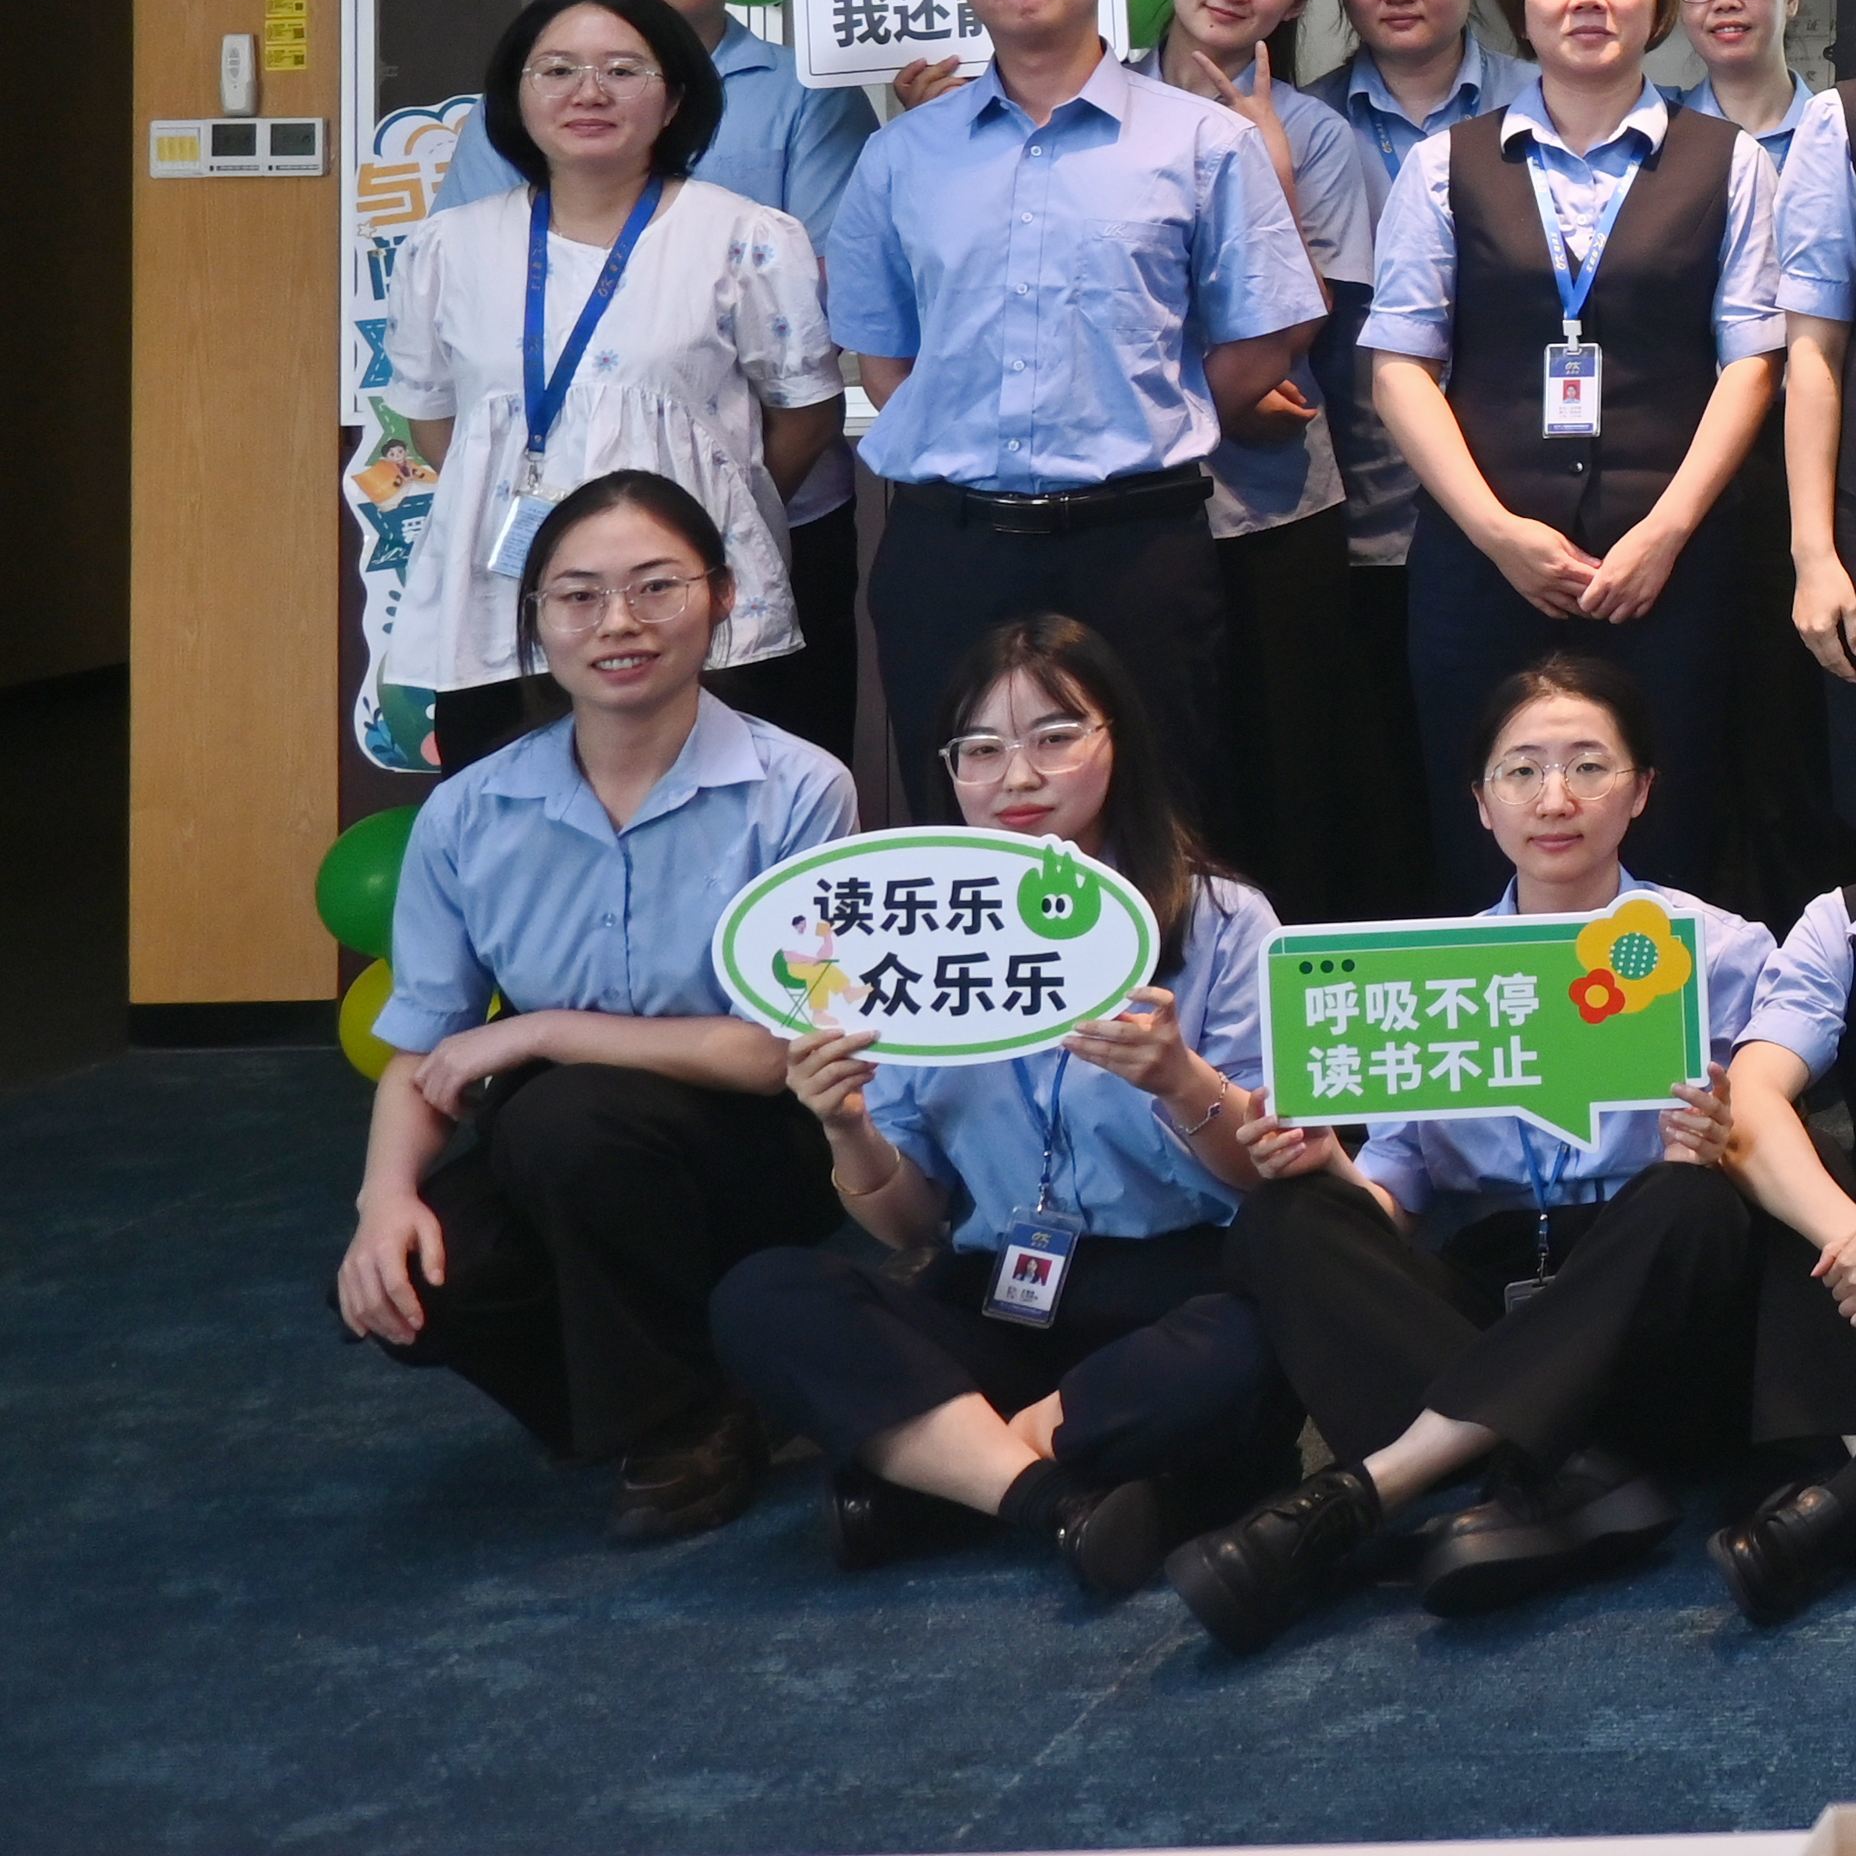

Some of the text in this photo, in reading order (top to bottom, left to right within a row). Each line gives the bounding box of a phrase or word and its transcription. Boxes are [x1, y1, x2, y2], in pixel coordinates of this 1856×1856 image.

[813, 876, 1005, 936] 读乐乐
[858, 951, 1067, 1017] 众乐乐
[1304, 972, 1540, 1036] 呼吸不停
[1305, 1035, 1543, 1099] 读书不止
